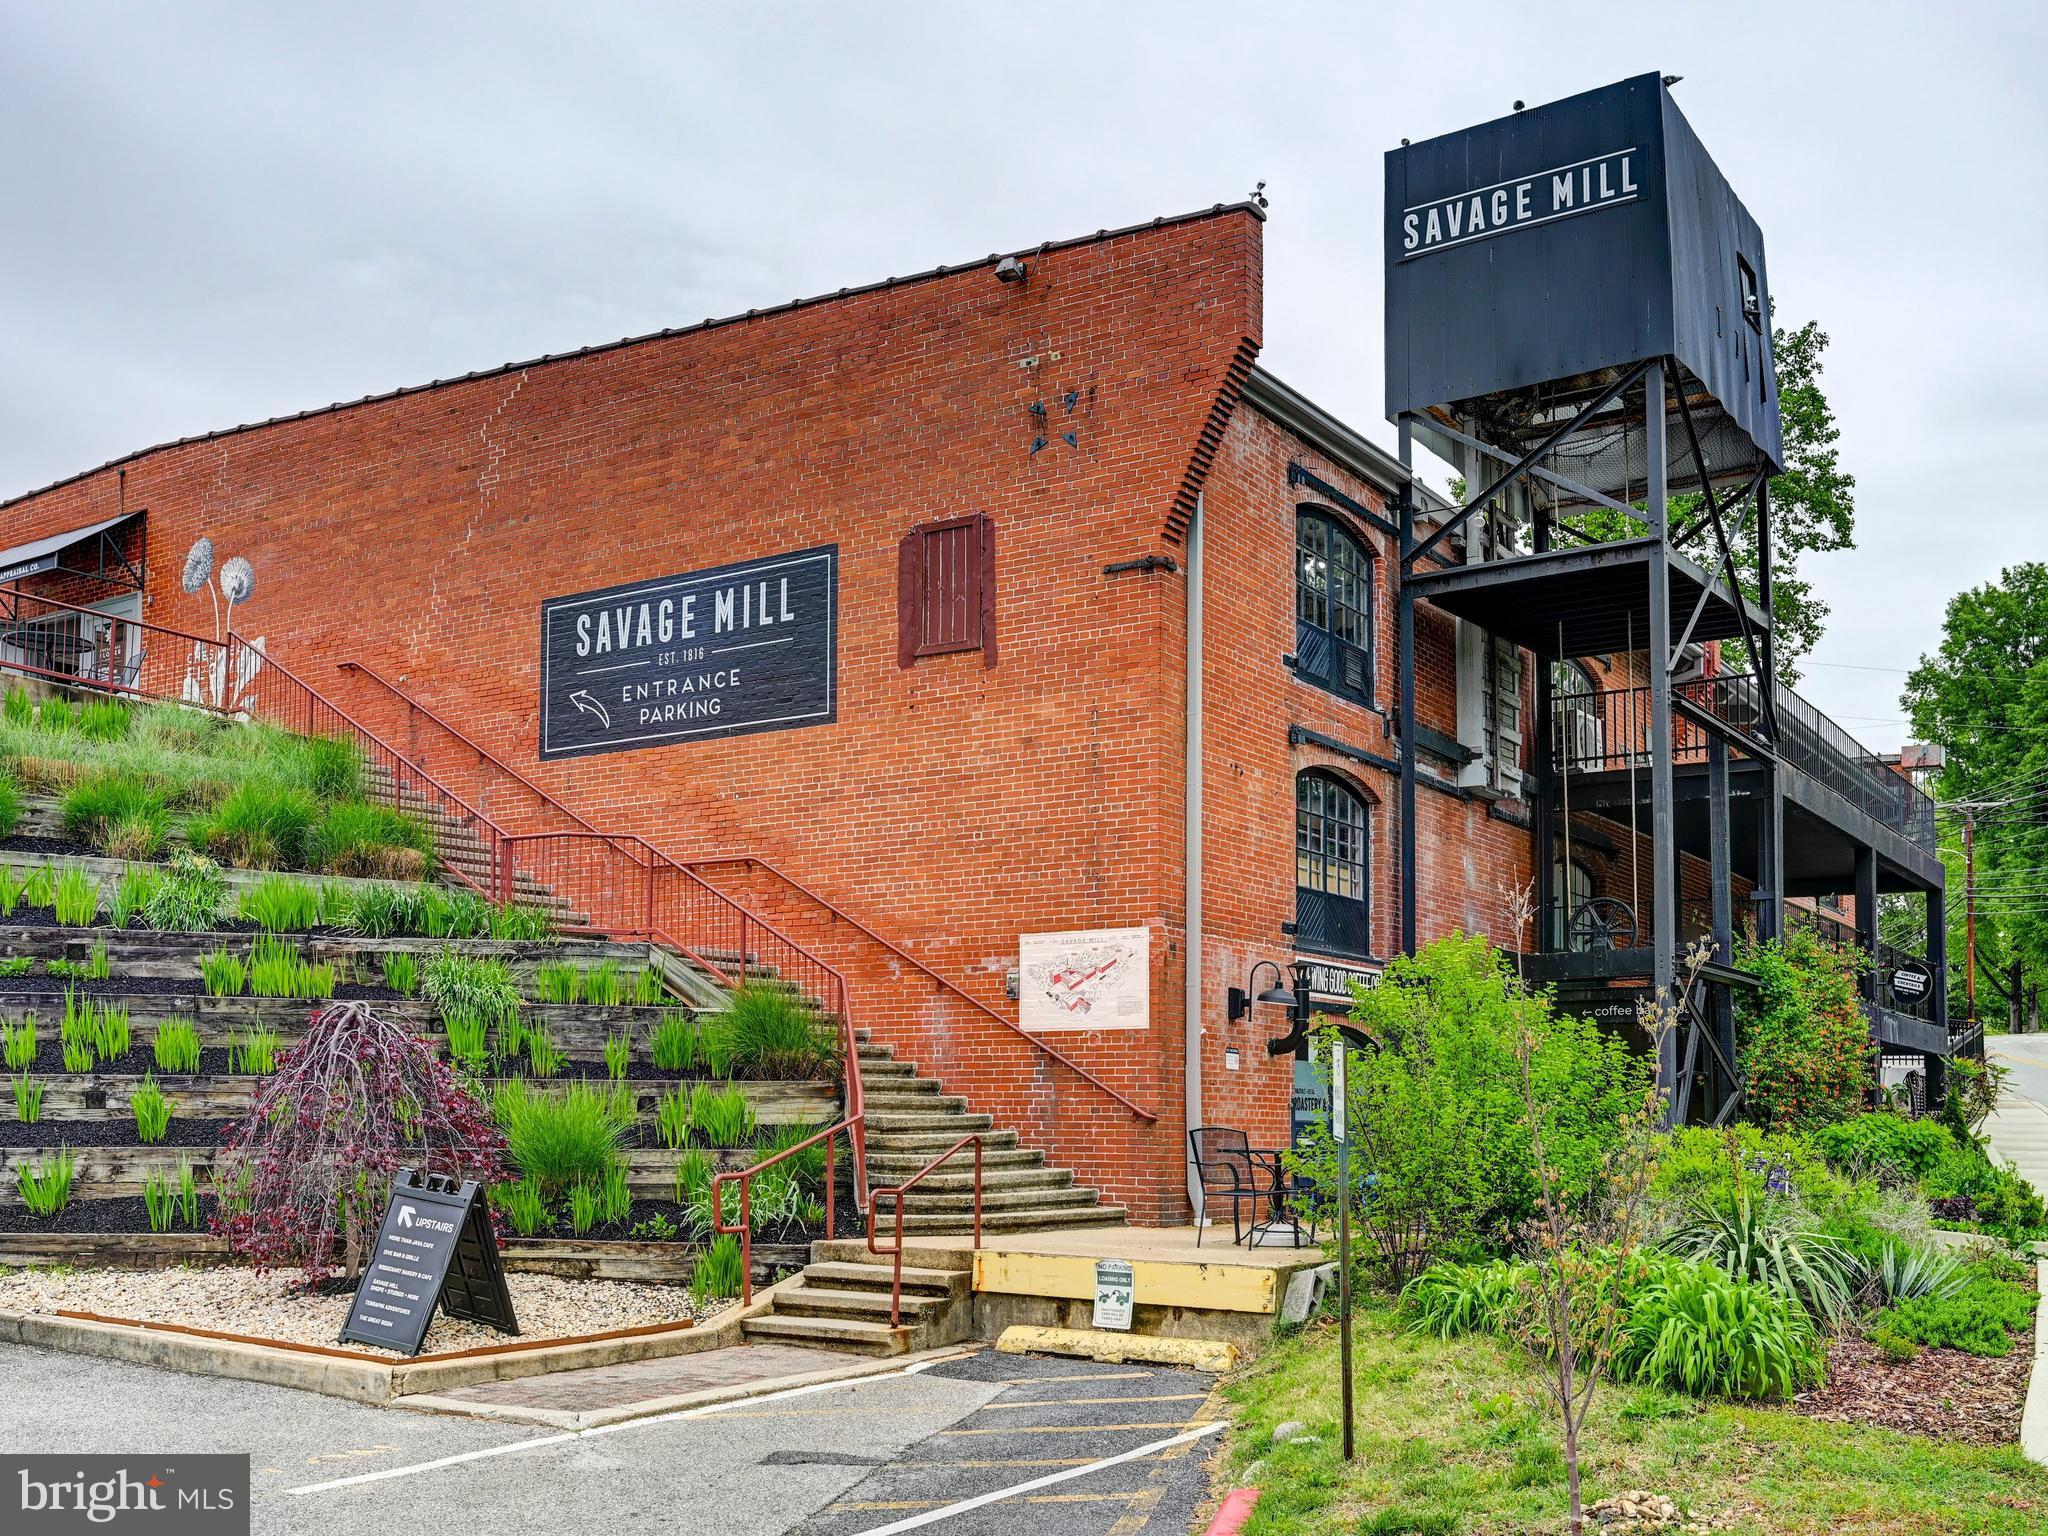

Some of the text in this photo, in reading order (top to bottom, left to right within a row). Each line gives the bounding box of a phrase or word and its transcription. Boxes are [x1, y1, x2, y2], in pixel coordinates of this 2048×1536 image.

[1403, 156, 1638, 250] SAVAGE MILL
[0, 562, 40, 579] APPRAISAL CO.
[576, 577, 795, 657] SAVAGE MILL
[658, 647, 704, 666] EST. 1816
[622, 668, 741, 702] ENTRANCE
[640, 698, 721, 725] PARKING
[1329, 968, 1347, 994] GOOD
[1897, 979, 1921, 989] COCKTAILS
[1594, 1004, 1632, 1017] coffee
[415, 1217, 454, 1233] UPSTAIRS
[401, 1269, 418, 1277] BAKERY
[1108, 1264, 1132, 1272] PARKING
[372, 1278, 389, 1287] SAVAGE
